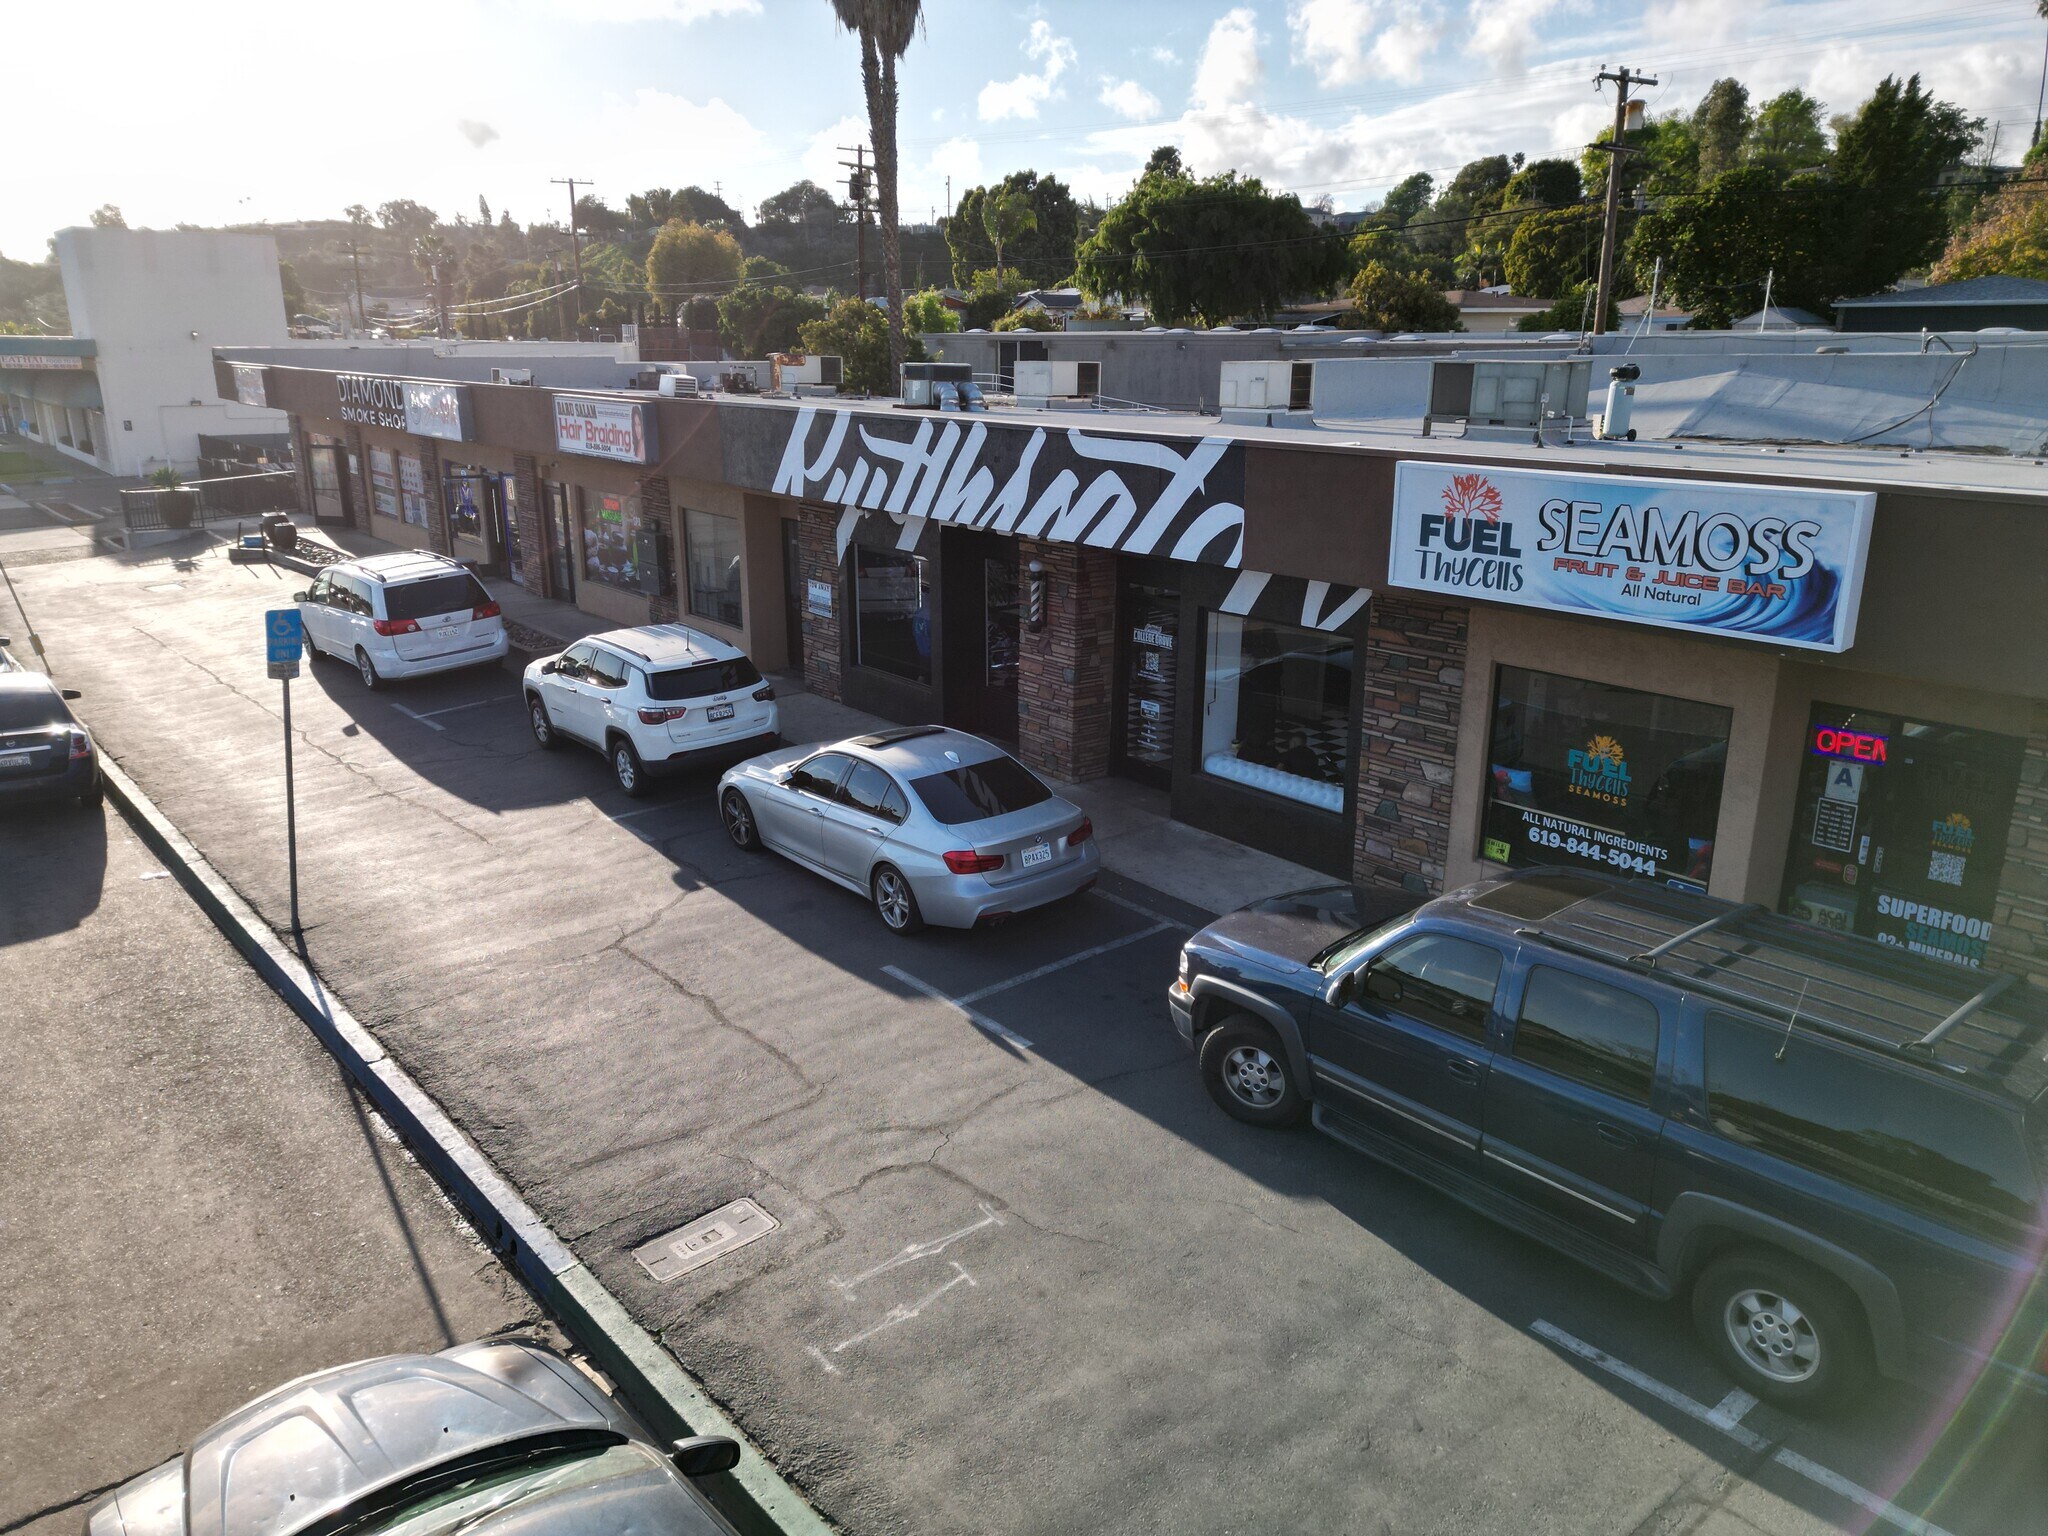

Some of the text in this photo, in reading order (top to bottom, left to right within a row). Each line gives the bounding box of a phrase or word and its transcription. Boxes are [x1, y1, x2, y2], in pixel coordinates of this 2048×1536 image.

[336, 375, 404, 410] DIAMOND
[341, 406, 376, 425] SMOKE
[559, 417, 631, 453] Hair Braiding
[1419, 513, 1522, 558] FUEL
[1537, 498, 1822, 580] SEAMOSS
[1414, 549, 1524, 592] Thycells
[1553, 557, 1786, 600] FRUIT & JUICE BAR
[1621, 583, 1701, 606] All Natural
[1133, 630, 1173, 648] COLLEGE GROVE
[1816, 729, 1887, 762] OPEN
[1567, 748, 1632, 782] FUEL
[1569, 767, 1629, 797] Thycells
[1834, 767, 1853, 787] A
[1568, 784, 1627, 807] SEAMOSS
[1522, 811, 1668, 860] ALL NATURAL INGREDIENTS
[1528, 826, 1656, 877] 619-844-5044
[1877, 894, 1993, 942] SUPERFOOD
